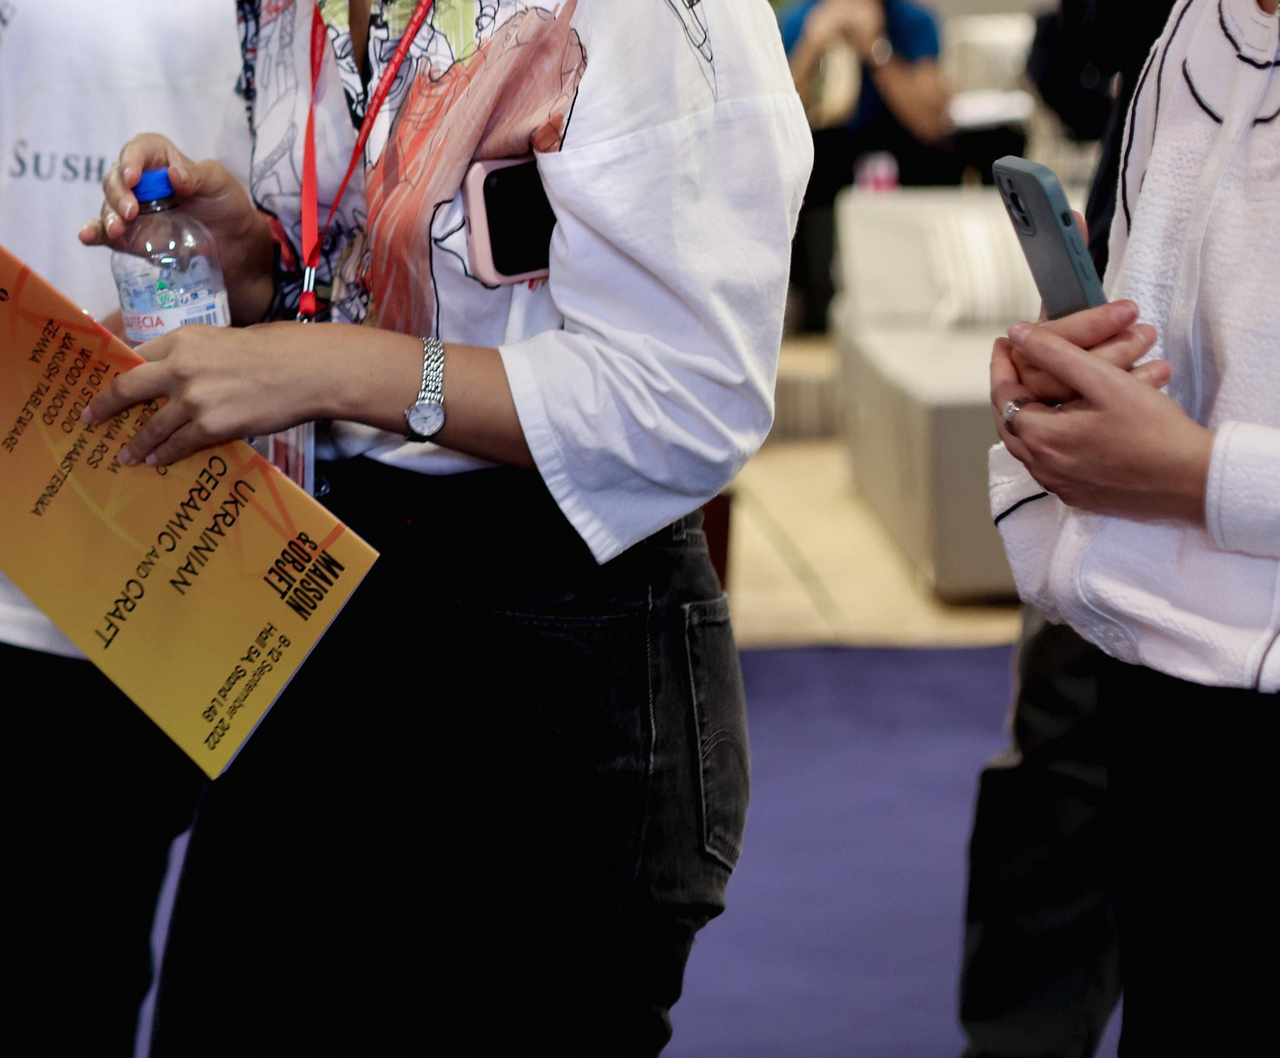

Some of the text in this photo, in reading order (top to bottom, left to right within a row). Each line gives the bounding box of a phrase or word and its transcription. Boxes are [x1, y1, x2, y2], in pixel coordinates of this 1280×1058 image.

[9, 139, 106, 183] SUSH
[64, 347, 93, 387] WOOD
[1, 381, 51, 453] TABLEWARE
[41, 383, 71, 426] MOOD
[61, 387, 94, 434] STUDIO
[157, 454, 228, 553] CERAMIC
[169, 479, 256, 596] UKRAINIAN
[136, 545, 161, 580] AND
[263, 531, 319, 601] &OBJET
[285, 549, 346, 622] MAISON
[95, 578, 145, 650] CRAFT
[255, 622, 278, 649] Hall
[217, 664, 247, 702] Stand
[227, 659, 274, 720] September
[203, 717, 231, 751] 2022
